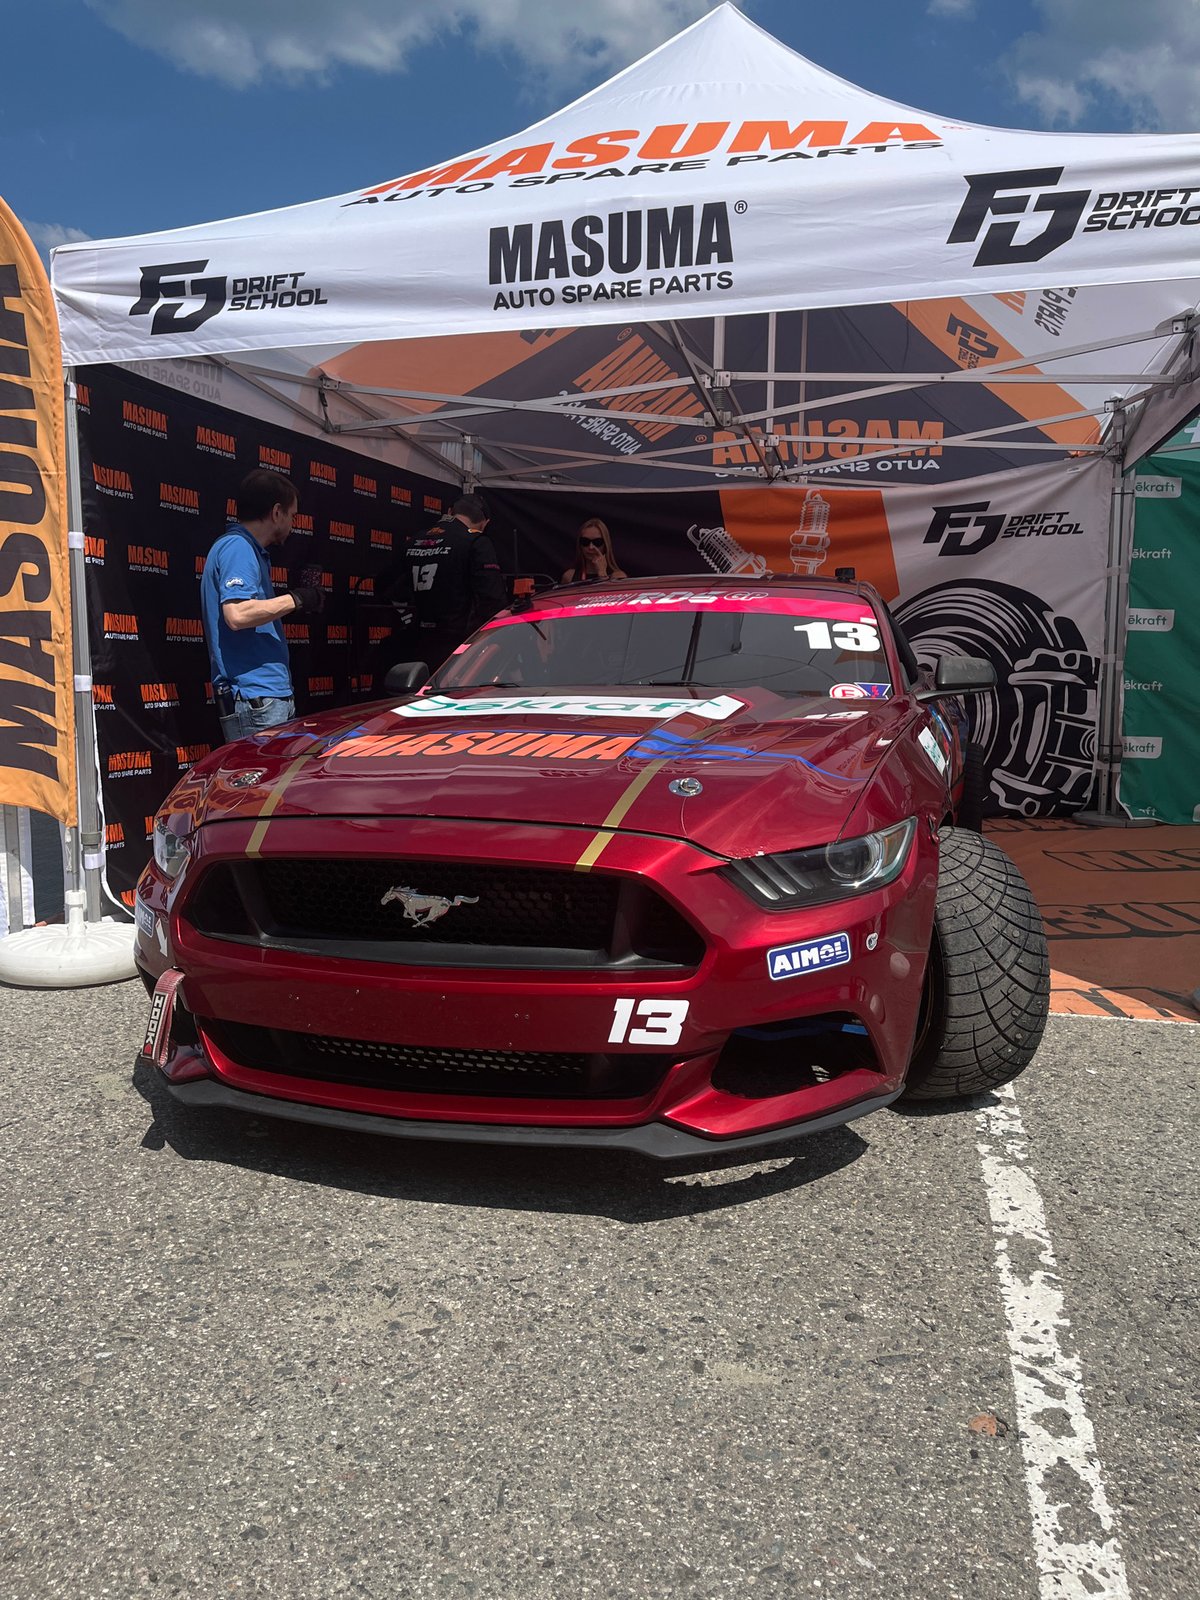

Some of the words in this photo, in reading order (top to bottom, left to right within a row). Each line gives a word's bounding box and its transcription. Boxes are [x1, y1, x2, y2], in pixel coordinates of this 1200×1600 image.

[360, 121, 942, 196] MASUMA
[340, 182, 494, 207] AUTO
[508, 159, 710, 188] SPARE
[726, 142, 944, 167] PARTS
[1092, 188, 1200, 211] DRIFT
[1082, 205, 1200, 233] SCHOO
[489, 201, 734, 285] MASUMA
[232, 272, 306, 295] DRIFT
[493, 287, 555, 310] AUTO
[561, 279, 642, 304] SPARE
[649, 270, 734, 296] PARTS
[227, 288, 328, 311] SCHOOL
[122, 400, 168, 432] MASUMA
[123, 421, 136, 430] AUTO
[152, 430, 168, 440] PARTS
[196, 426, 236, 454] MASUMA
[259, 446, 291, 469] MASUMA
[309, 461, 337, 482] MASUMA
[160, 482, 199, 508] MASUMA
[1001, 523, 1084, 538] SCHOOL
[1007, 511, 1070, 527] DRIFT
[412, 563, 439, 592] 13
[627, 592, 726, 605] RDS
[794, 621, 881, 652] 13
[317, 731, 643, 761] MASUMA
[108, 751, 152, 772] MASUMA
[134, 768, 152, 776] PARTS
[773, 941, 848, 975] AIMOL
[145, 993, 166, 1043] HOOK
[607, 998, 690, 1045] 13
